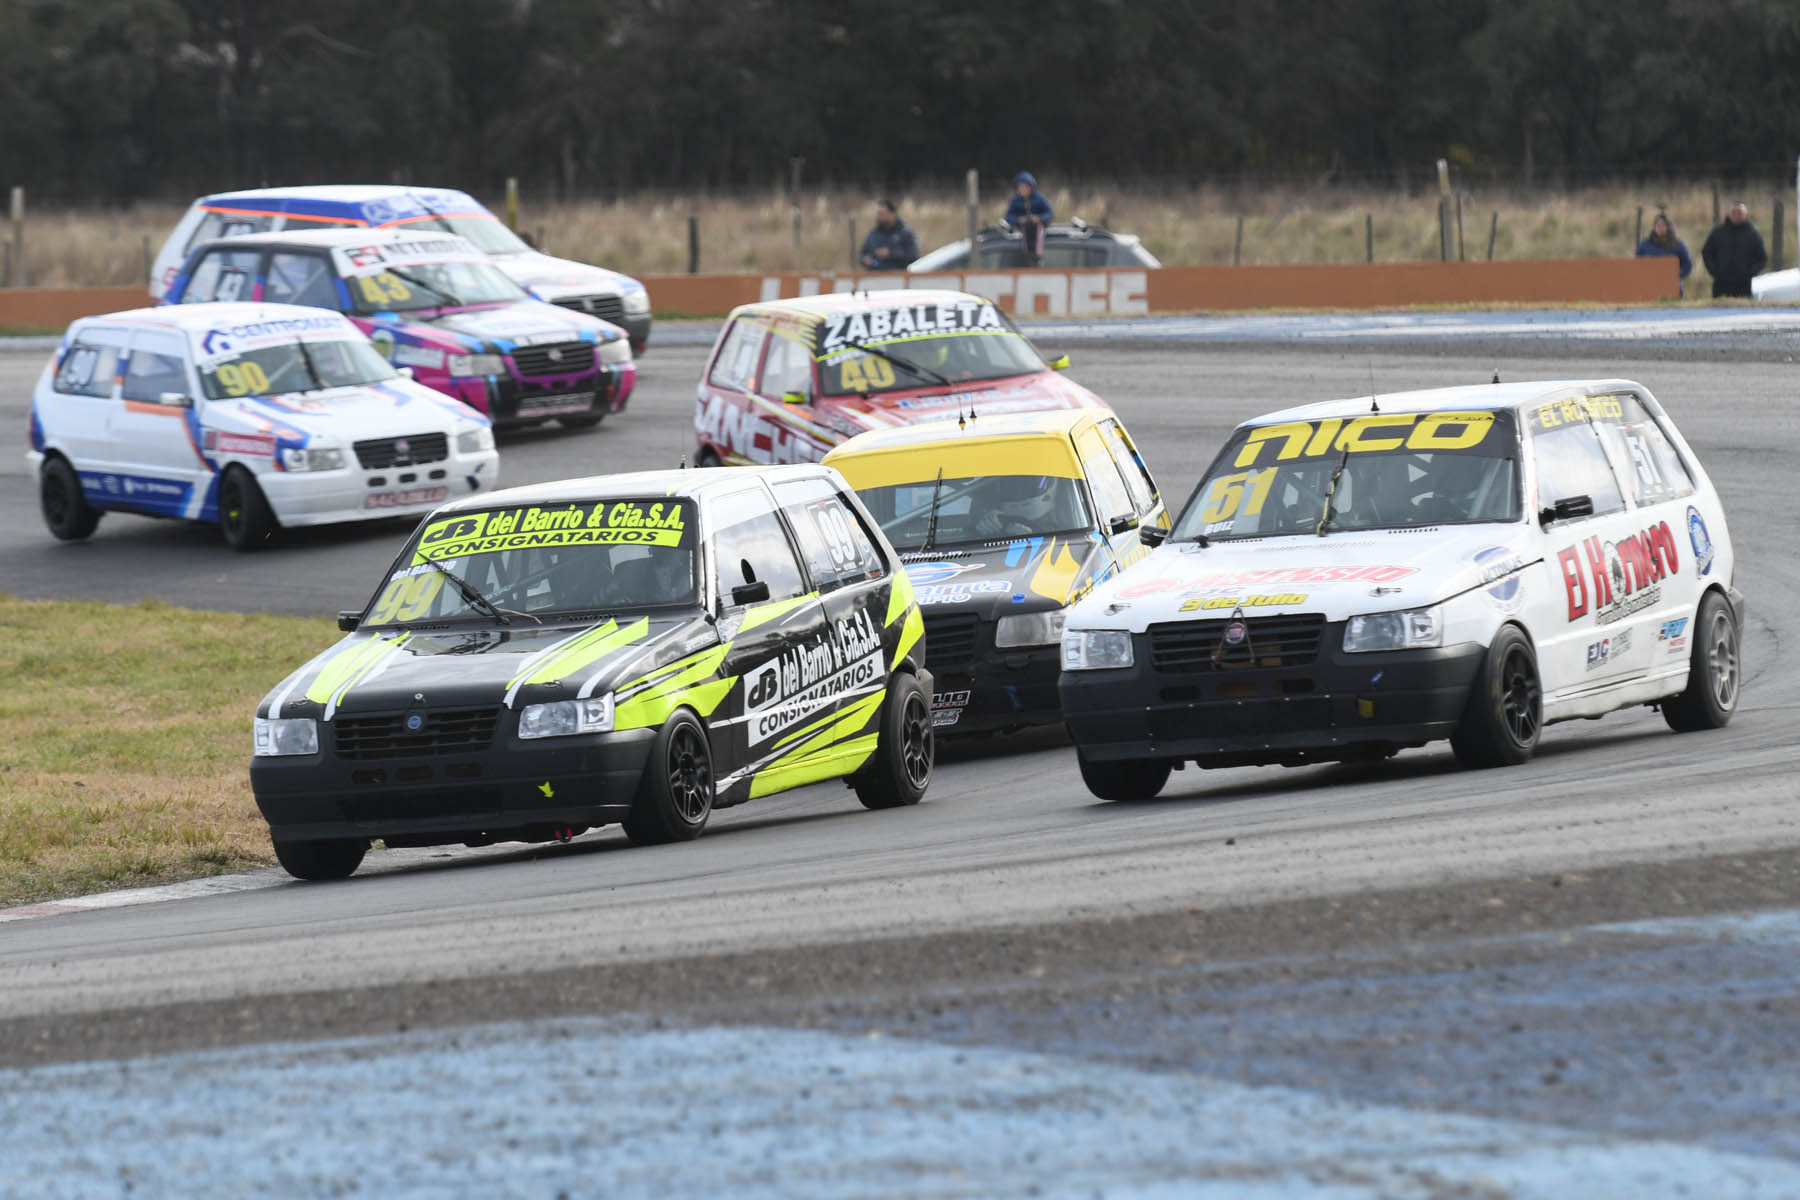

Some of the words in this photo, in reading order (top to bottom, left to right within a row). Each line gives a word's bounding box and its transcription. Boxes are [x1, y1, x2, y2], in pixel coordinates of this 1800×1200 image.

[359, 272, 412, 304] 43
[823, 302, 1002, 347] ZABALETA
[216, 361, 271, 397] 90
[840, 354, 896, 393] 40
[1202, 467, 1279, 524] 51
[486, 509, 522, 535] del
[522, 505, 579, 531] Barrio
[587, 507, 604, 527] &
[609, 502, 685, 530] Cia.S.A.
[818, 508, 856, 564] 99
[429, 531, 658, 559] CONSIGNATARIOS
[367, 571, 447, 625] 99
[1179, 598, 1200, 612] 9
[1200, 596, 1237, 610] de
[1237, 593, 1309, 608] Julio
[783, 649, 800, 697] del
[797, 634, 833, 688] Barrio
[838, 608, 881, 662] Cia.S.A.
[759, 659, 874, 736] CONSIGNATARIOS
